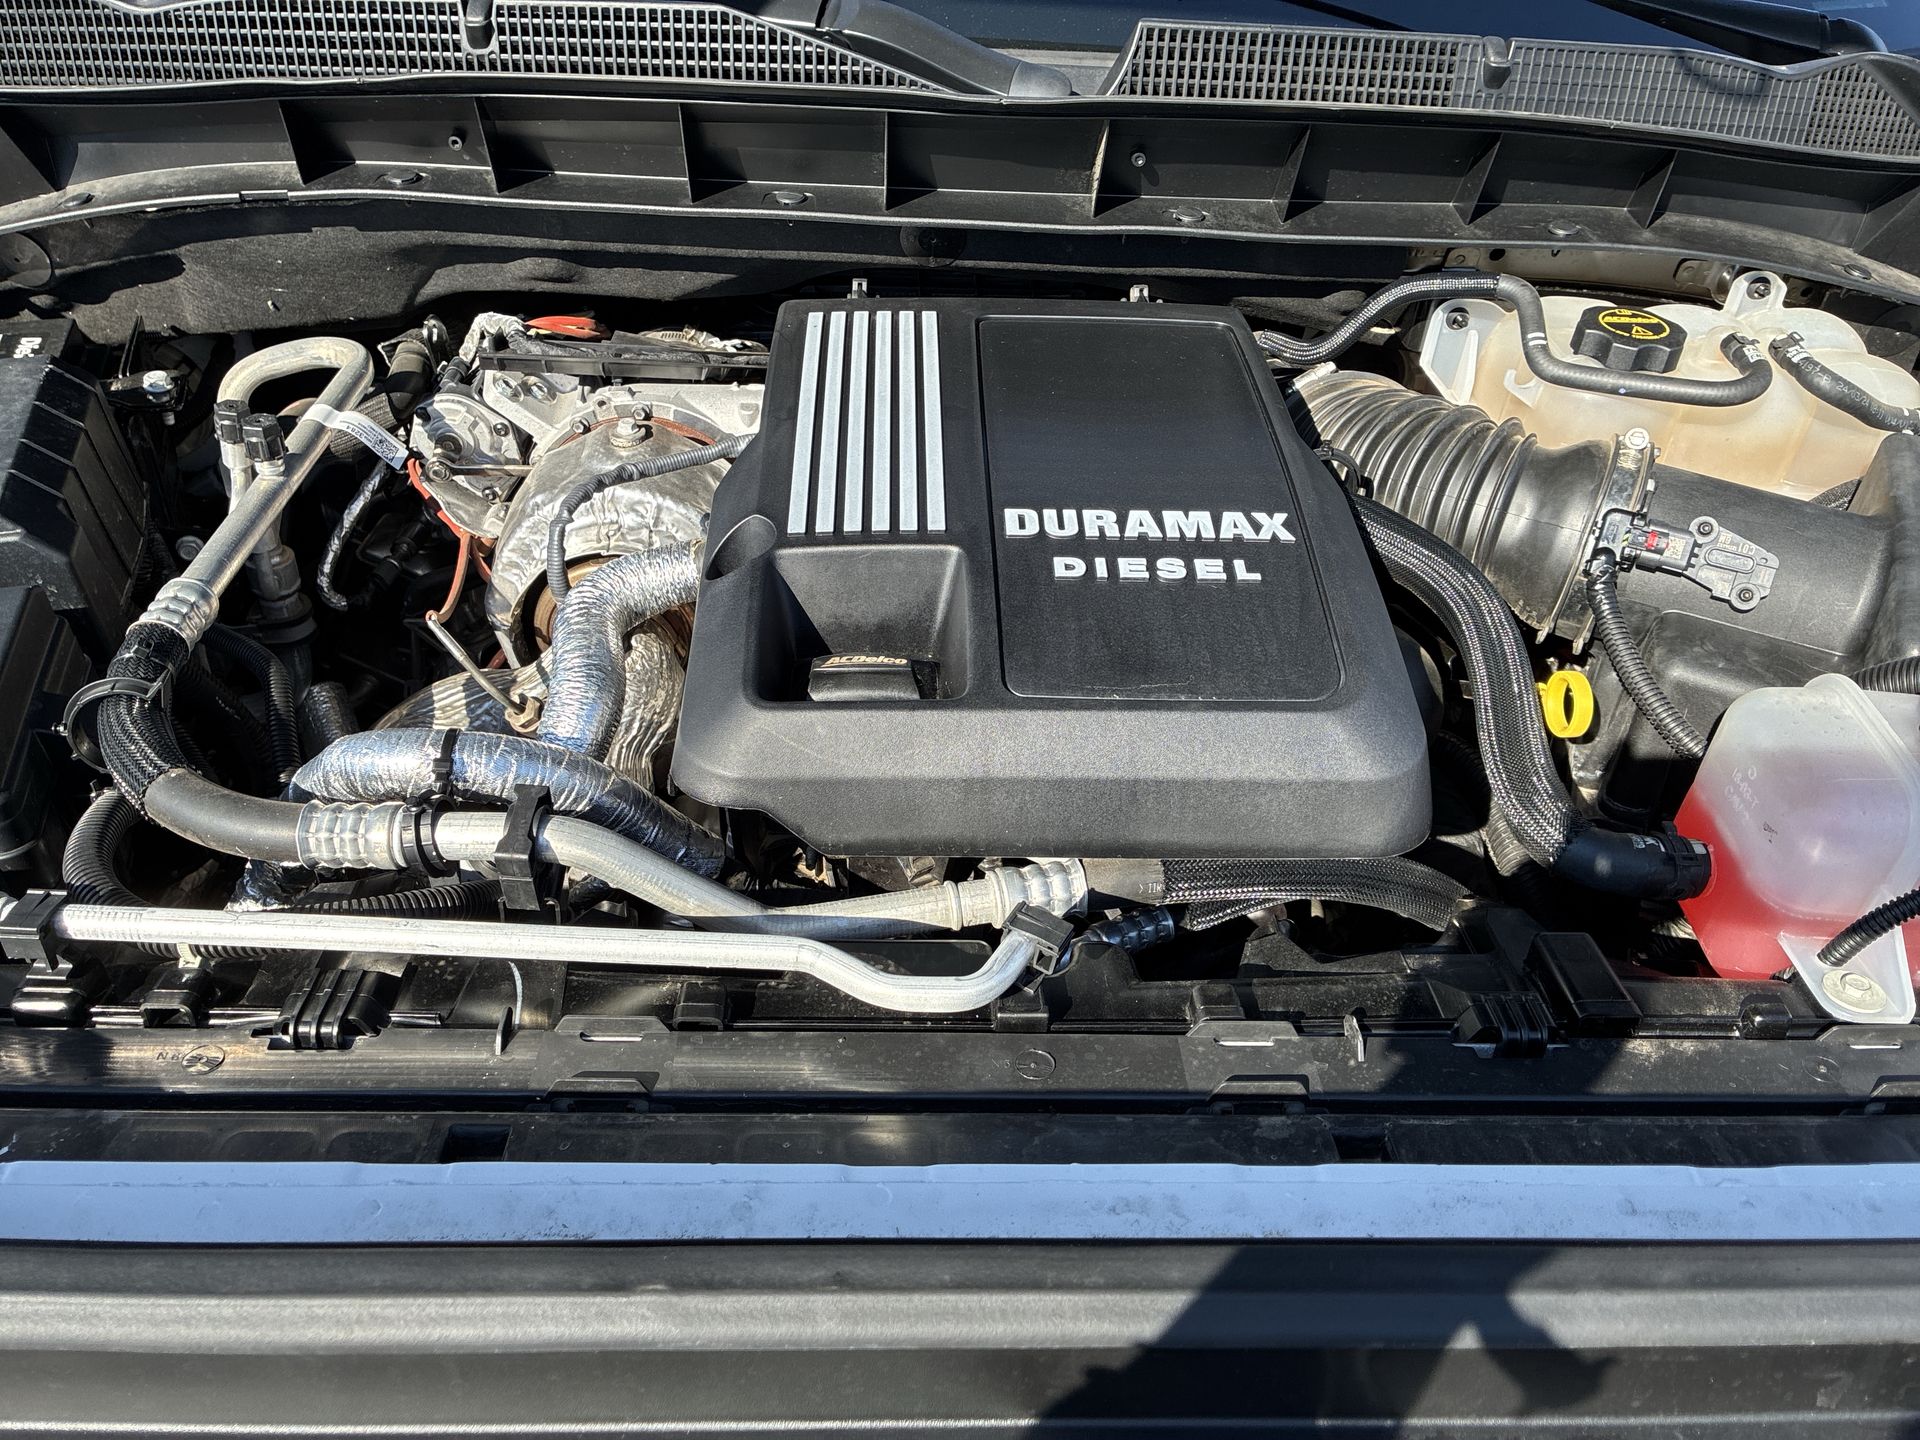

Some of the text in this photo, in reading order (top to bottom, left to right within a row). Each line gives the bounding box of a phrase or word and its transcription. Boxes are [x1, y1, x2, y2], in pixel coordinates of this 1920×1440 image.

[1003, 508, 1296, 543] DURAMAX
[1053, 556, 1262, 583] DIESEL
[824, 656, 908, 666] ACDelco
